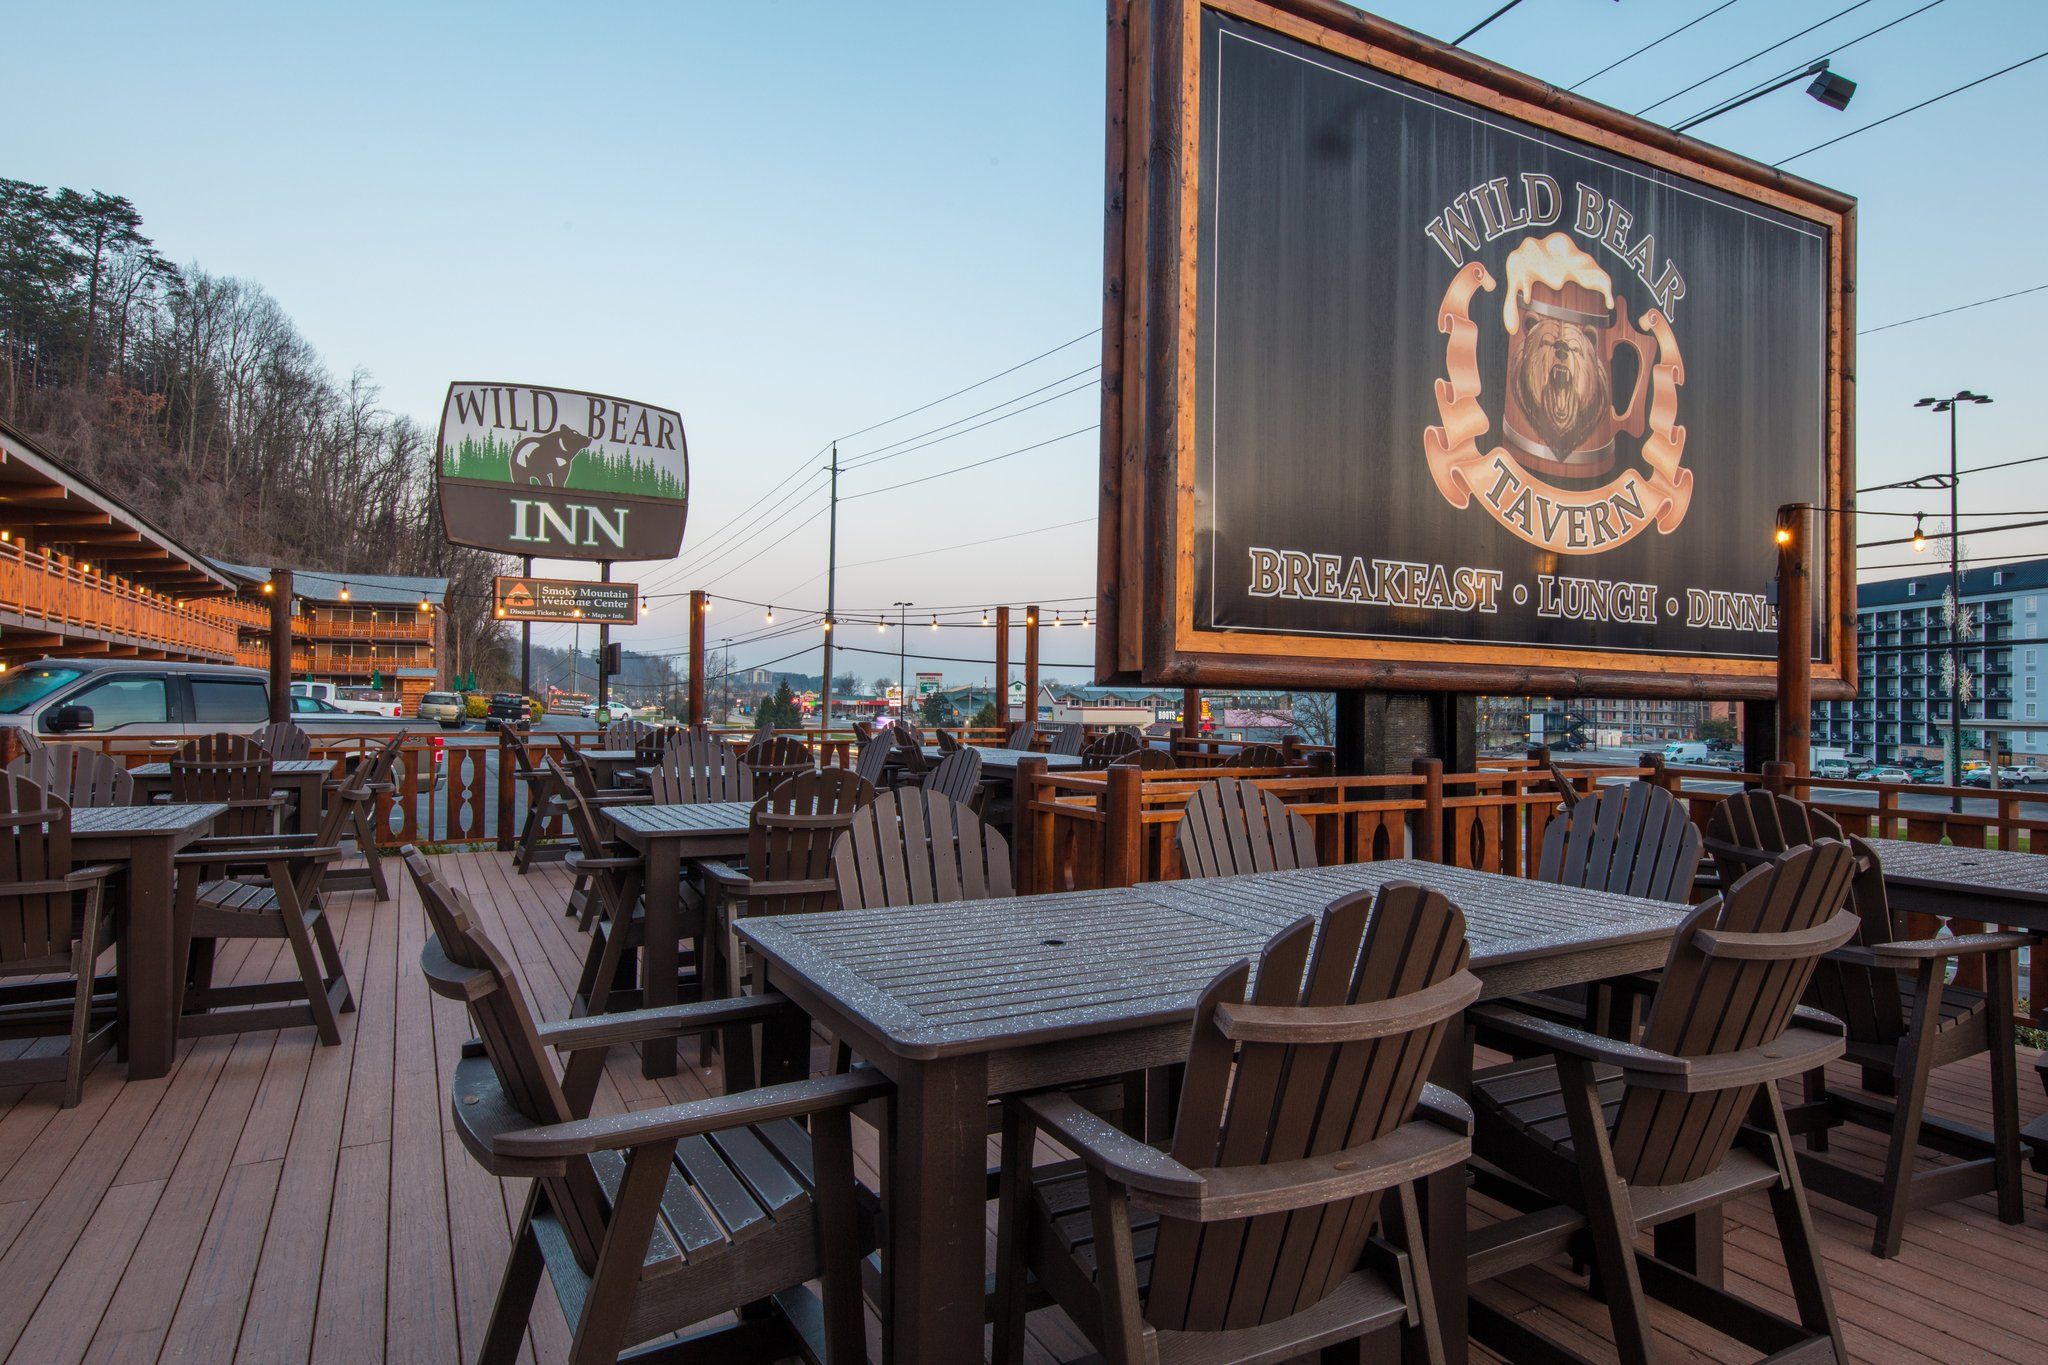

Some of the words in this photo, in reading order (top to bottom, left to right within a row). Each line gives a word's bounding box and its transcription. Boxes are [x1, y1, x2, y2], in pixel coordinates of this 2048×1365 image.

[1425, 172, 1563, 268] WILD
[1575, 182, 1687, 323] BEAR
[454, 388, 558, 434] WILD
[587, 397, 677, 450] BEAR
[509, 498, 629, 548] INN
[1485, 457, 1646, 550] TAVERN
[542, 586, 578, 598] Smoky
[580, 588, 628, 599] Mountain
[542, 595, 591, 607] Welcome
[594, 598, 628, 609] Center
[1248, 548, 1502, 613] BREAKFAST
[1538, 575, 1658, 625] LUNCH
[510, 608, 536, 616] Discount
[1158, 711, 1176, 720] BOOTS
